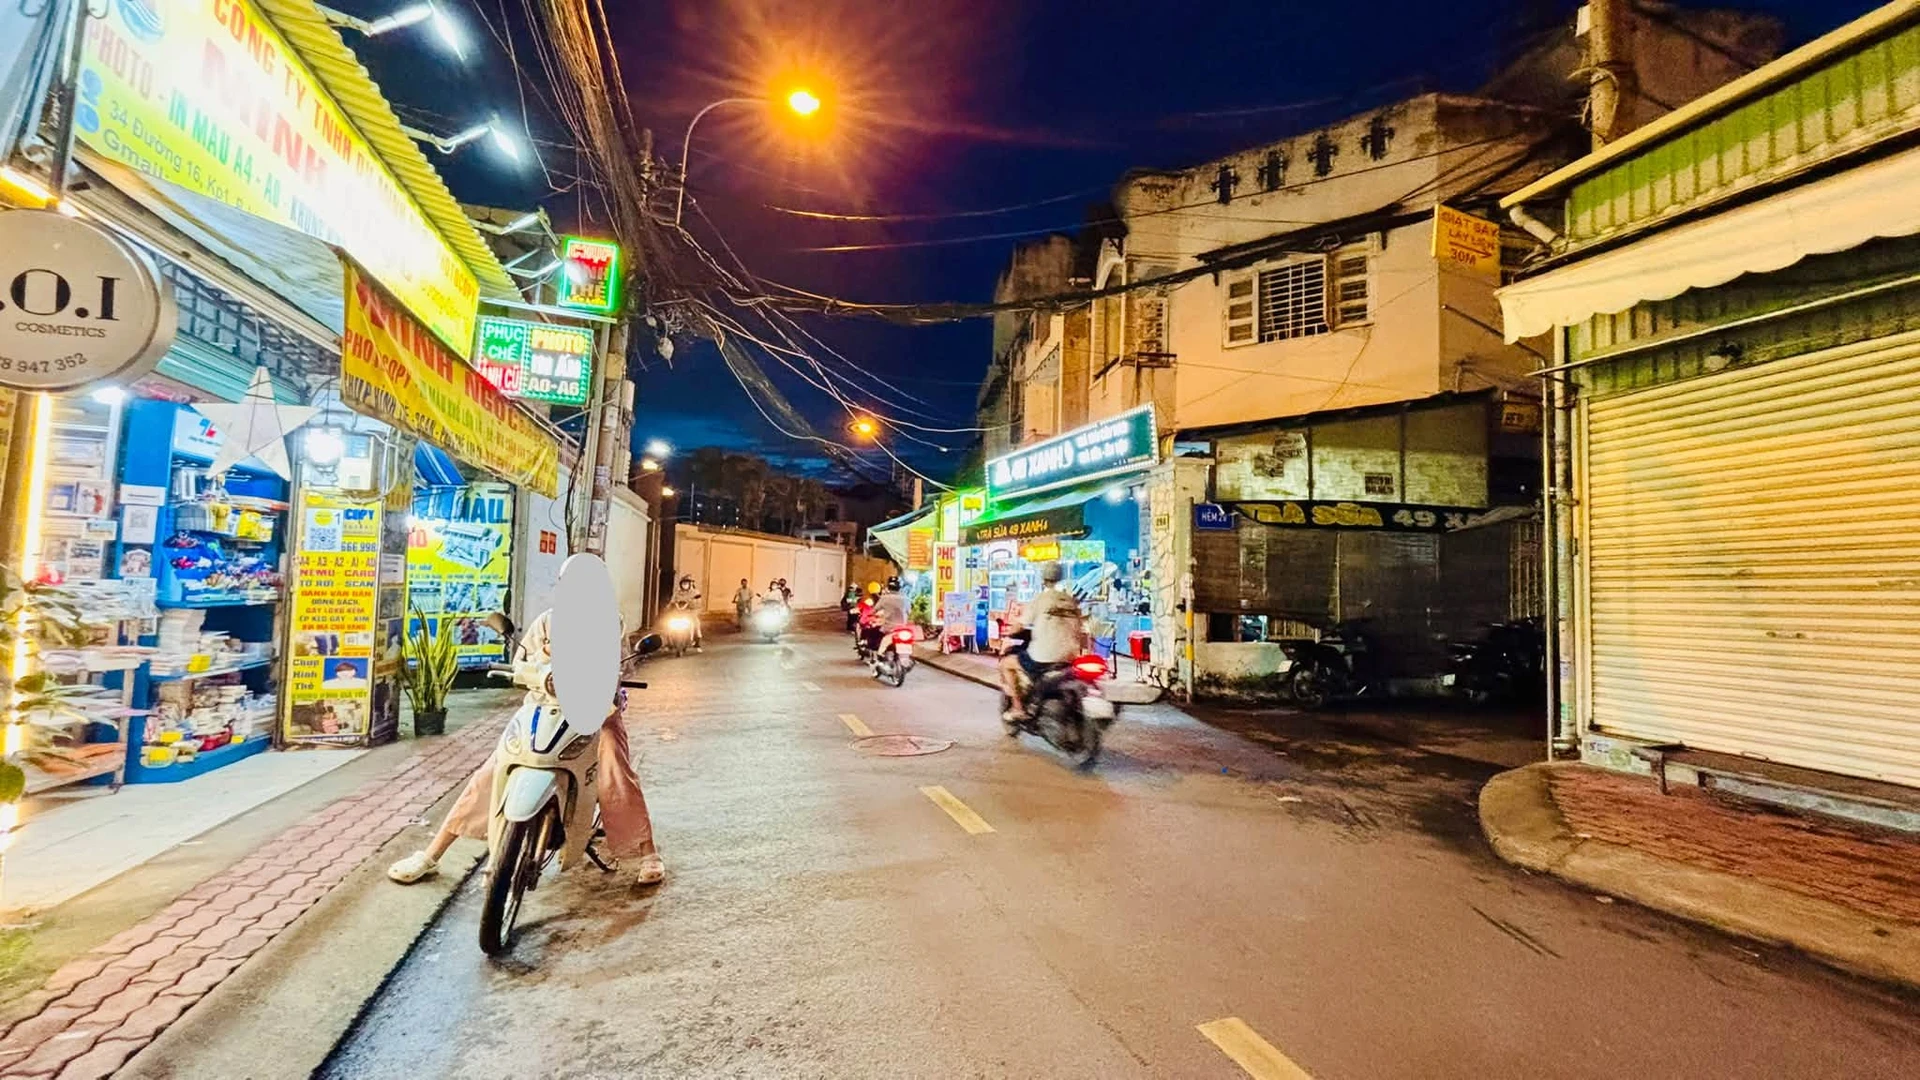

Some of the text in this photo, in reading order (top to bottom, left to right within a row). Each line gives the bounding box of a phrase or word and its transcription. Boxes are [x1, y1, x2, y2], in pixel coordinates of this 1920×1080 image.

[283, 63, 308, 110] TY
[313, 99, 352, 165] TNHH
[168, 88, 188, 131] IN
[233, 145, 254, 185] A4
[15, 322, 107, 338] COSMETICS
[485, 323, 524, 342] PHỤC
[531, 329, 587, 352] PHOTO
[487, 342, 519, 361] CHẾ
[17, 360, 50, 374] 947
[54, 352, 88, 371] 352
[344, 509, 375, 520] COPY
[1393, 509, 1437, 527] 49
[938, 565, 953, 580] TO
